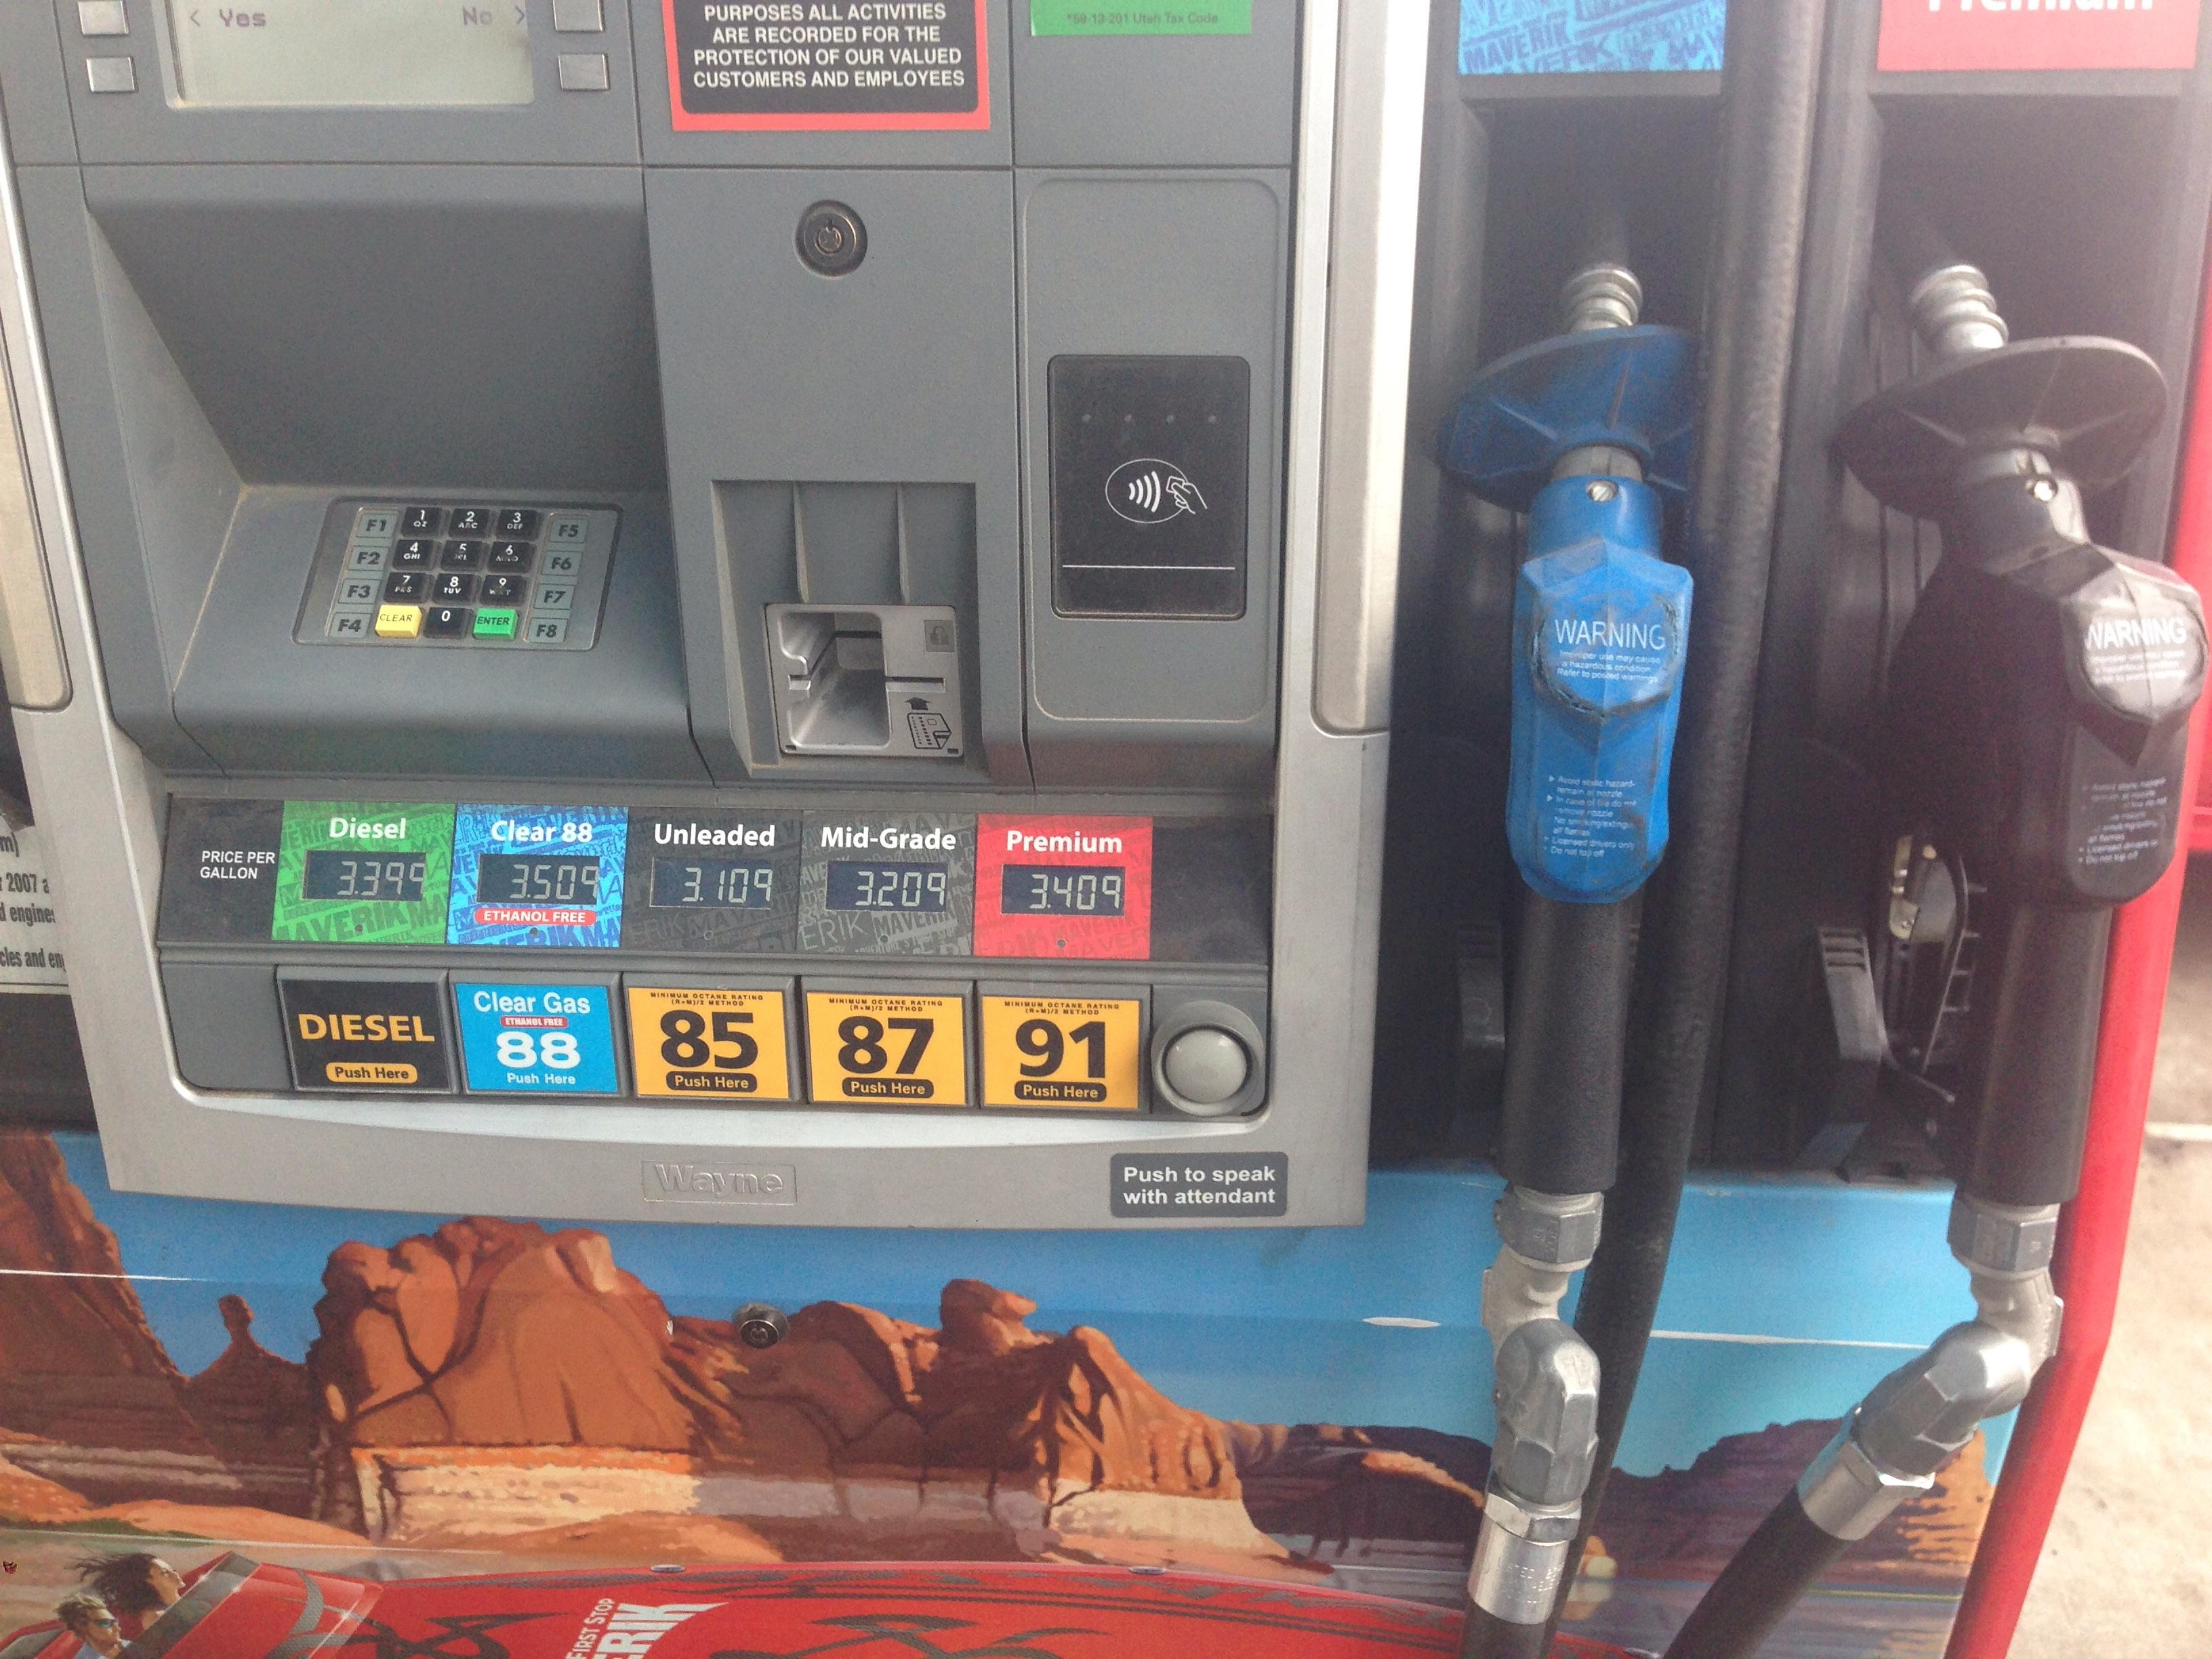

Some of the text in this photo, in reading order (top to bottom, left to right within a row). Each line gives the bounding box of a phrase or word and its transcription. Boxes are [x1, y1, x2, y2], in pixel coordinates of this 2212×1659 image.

[219, 6, 493, 27] Yes No
[705, 3, 946, 22] PURPOSES ALL ACTIVITIES
[712, 26, 941, 43] ARE RECORDED FOR THE
[694, 48, 962, 66] PROTECTION OF OUR VALUED
[694, 70, 964, 88] CUSTOMERS AND EMPLOYEES
[420, 510, 426, 520] 1
[465, 511, 475, 522] 2
[513, 512, 521, 523] 3
[366, 518, 387, 532] F1
[558, 524, 579, 537] F5
[409, 541, 419, 553] 4
[459, 543, 467, 553] 5
[506, 544, 513, 555] 6
[356, 551, 381, 565] F2
[551, 556, 572, 570] F6
[403, 575, 411, 585] 7
[450, 575, 459, 587] 8
[499, 577, 507, 588] 9
[347, 585, 371, 598] F3
[544, 590, 566, 603] F7
[380, 613, 413, 622] CLEAR
[441, 610, 451, 622] 0
[477, 616, 510, 625] ENTER
[337, 619, 362, 632] F4
[536, 623, 557, 638] F8
[1555, 619, 1666, 651] WARNING
[329, 817, 406, 839] Diesel
[491, 819, 593, 842] Clear 88
[654, 823, 775, 846] Unleaded
[821, 826, 956, 850] Mid-Grade
[1006, 830, 1122, 853] Premium
[202, 851, 276, 864] PRICE PER
[200, 866, 258, 879] GALLON
[337, 861, 426, 896] 3.399
[6, 872, 37, 893] 2007
[510, 864, 600, 900] 3.509
[682, 867, 773, 903] 3.109
[855, 871, 946, 907] 3.209
[1029, 874, 1122, 910] 3.409
[483, 910, 586, 923] ETHANOL FREE
[24, 947, 46, 968] and
[474, 991, 591, 1014] Clear Gas
[298, 1013, 435, 1042] DIESEL
[505, 1017, 542, 1026] ETHANOL
[661, 1009, 758, 1069] 85
[838, 1016, 934, 1074] 87
[496, 1031, 581, 1069] 88
[1016, 1019, 1105, 1078] 91
[334, 1066, 409, 1079] Push Here
[507, 1073, 575, 1084] Push Here
[674, 1075, 749, 1088] Push Here
[851, 1082, 925, 1094] Push Here
[1023, 1084, 1099, 1098] Push Here
[654, 1164, 783, 1199] Wayne
[1124, 1166, 1275, 1185] Push to speak
[1123, 1188, 1275, 1204] with attendant
[583, 1598, 615, 1624] STOP
